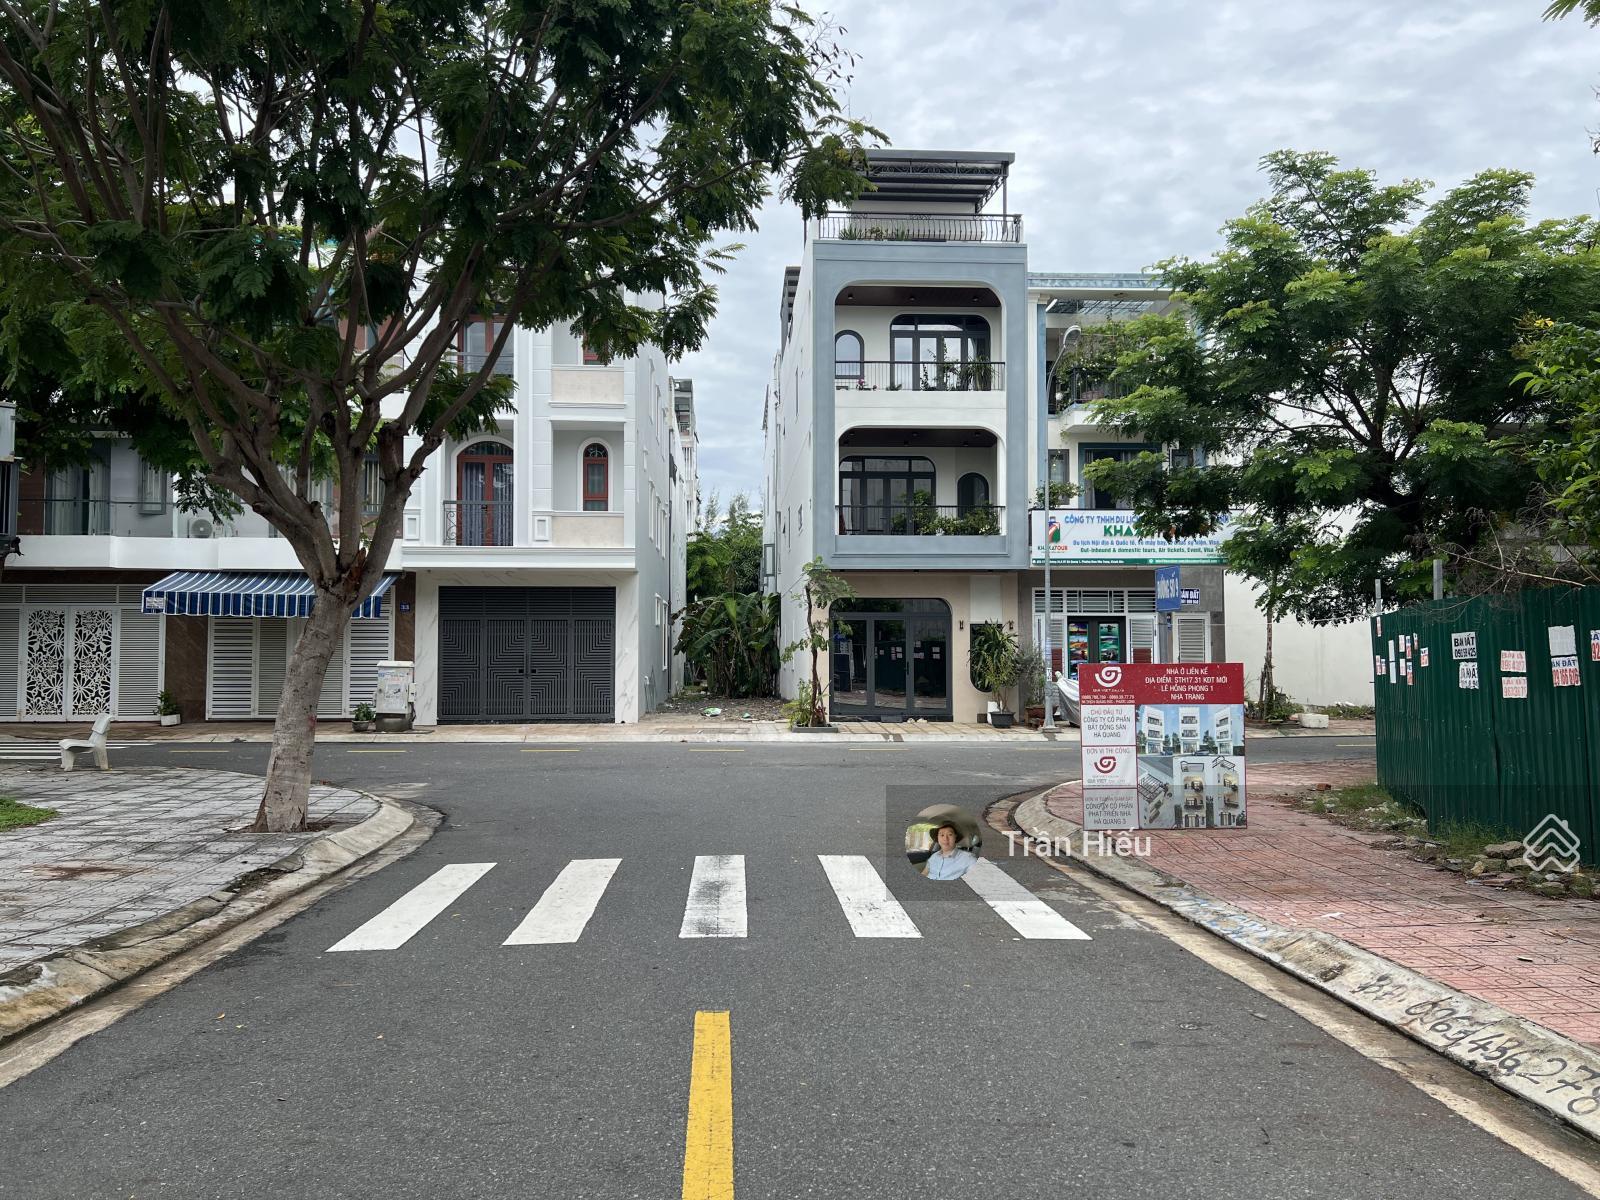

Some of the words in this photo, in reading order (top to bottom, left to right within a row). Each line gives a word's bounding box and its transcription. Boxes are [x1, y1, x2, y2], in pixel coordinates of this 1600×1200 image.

[1065, 514, 1084, 524] CÔNG
[1086, 516, 1095, 524] TY
[1116, 516, 1125, 524] DU
[1166, 667, 1179, 675] NHÀ
[1186, 667, 1199, 675] LIÊN
[1145, 676, 1155, 684] ĐỊA
